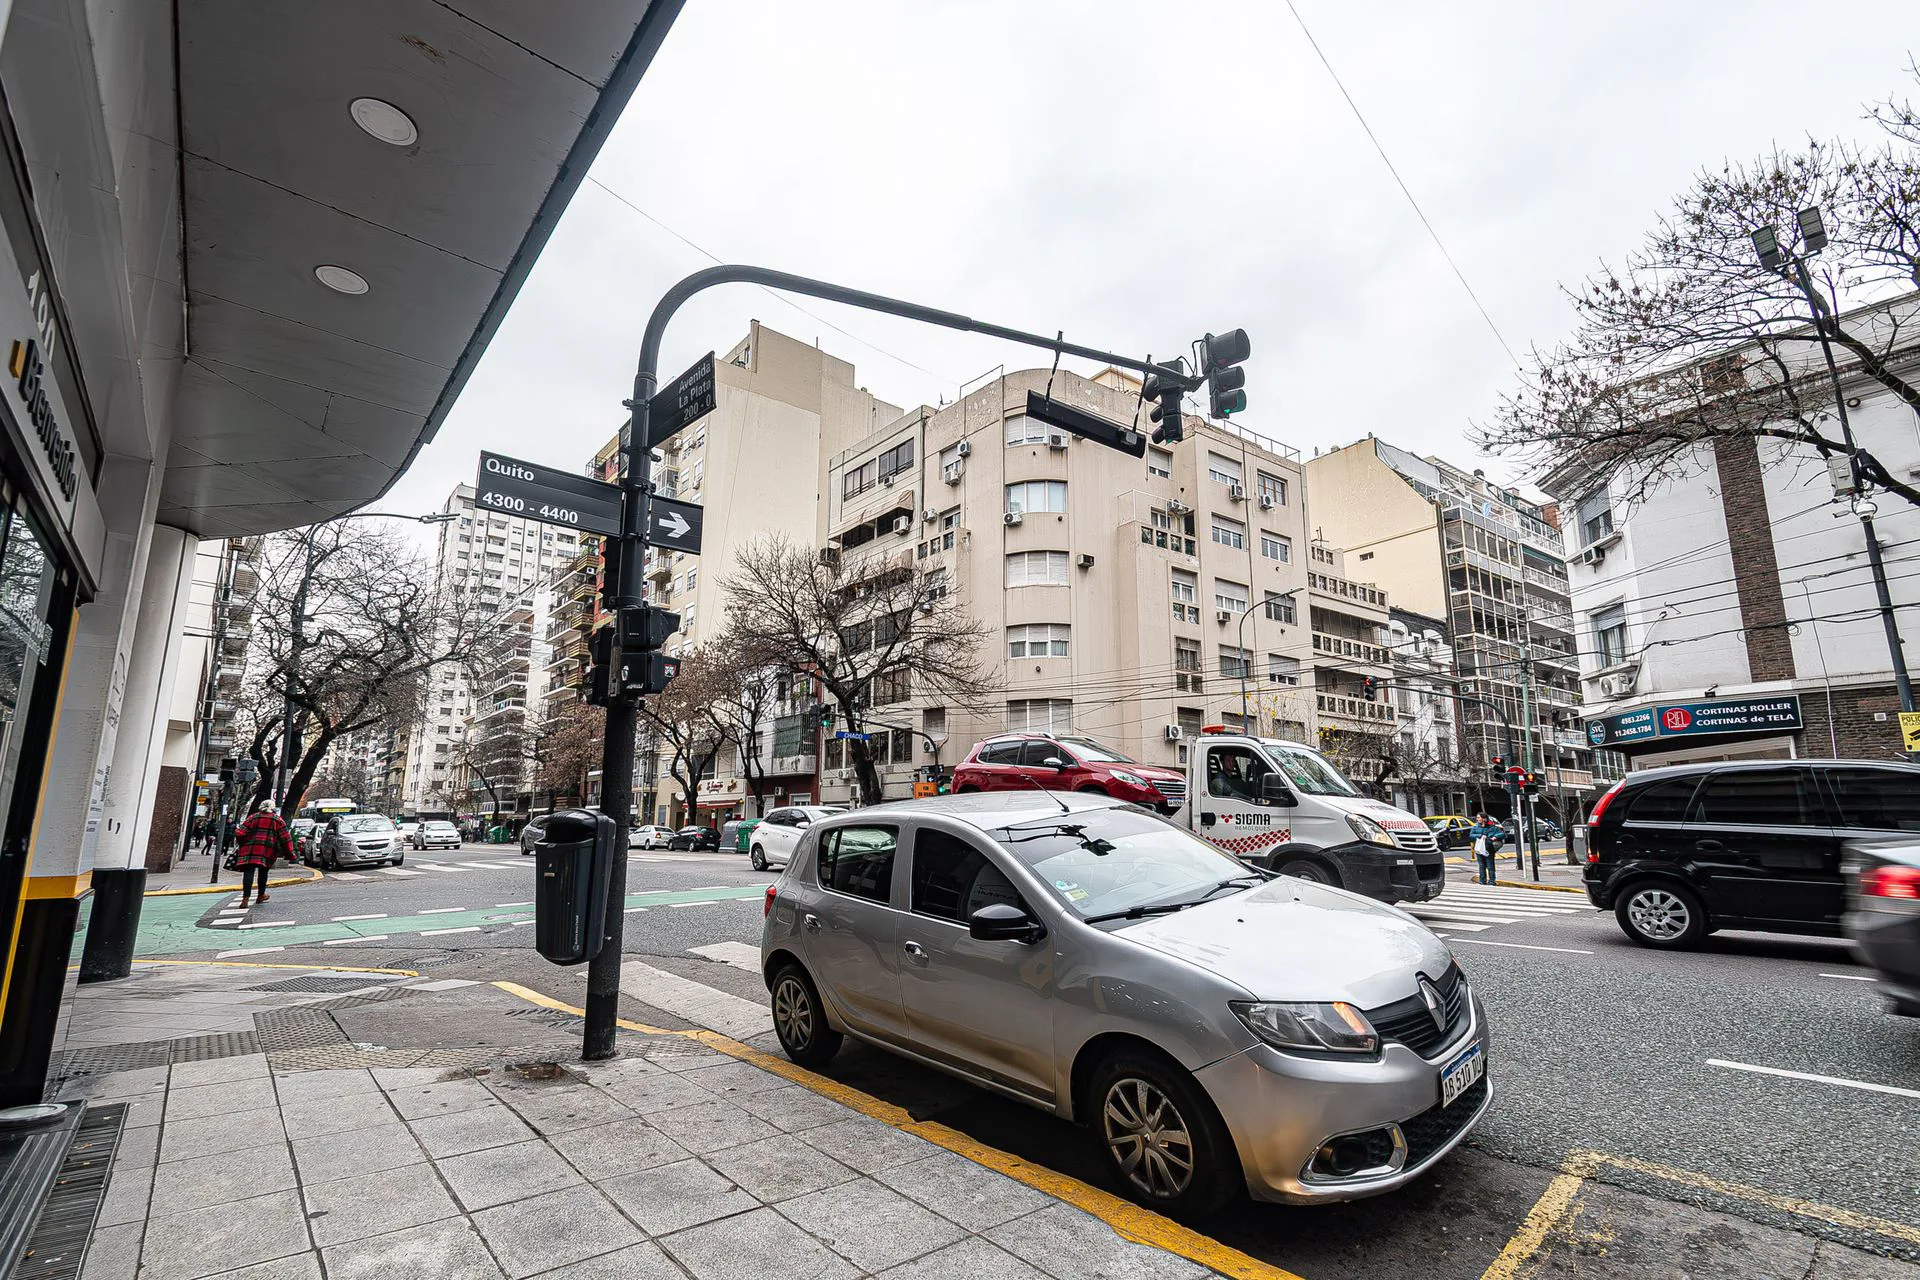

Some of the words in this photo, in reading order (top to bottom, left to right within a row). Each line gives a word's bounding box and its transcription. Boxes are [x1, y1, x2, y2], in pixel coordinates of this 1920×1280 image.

[679, 362, 711, 394] Avenida
[678, 395, 689, 409] La
[690, 380, 711, 401] Plata
[683, 402, 699, 420] 200
[705, 394, 712, 407] 0
[485, 458, 535, 482] Quito
[482, 491, 525, 513] 4300
[539, 505, 579, 525] 4400
[1695, 706, 1747, 716] CORTINAS
[1749, 702, 1791, 712] ROLLER
[1695, 716, 1748, 726] CORTINAS
[1750, 715, 1765, 723] de
[1766, 713, 1795, 722] TELA
[1235, 813, 1271, 825] SIGMA
[1444, 1078, 1455, 1103] AB
[1455, 1063, 1471, 1091] 510
